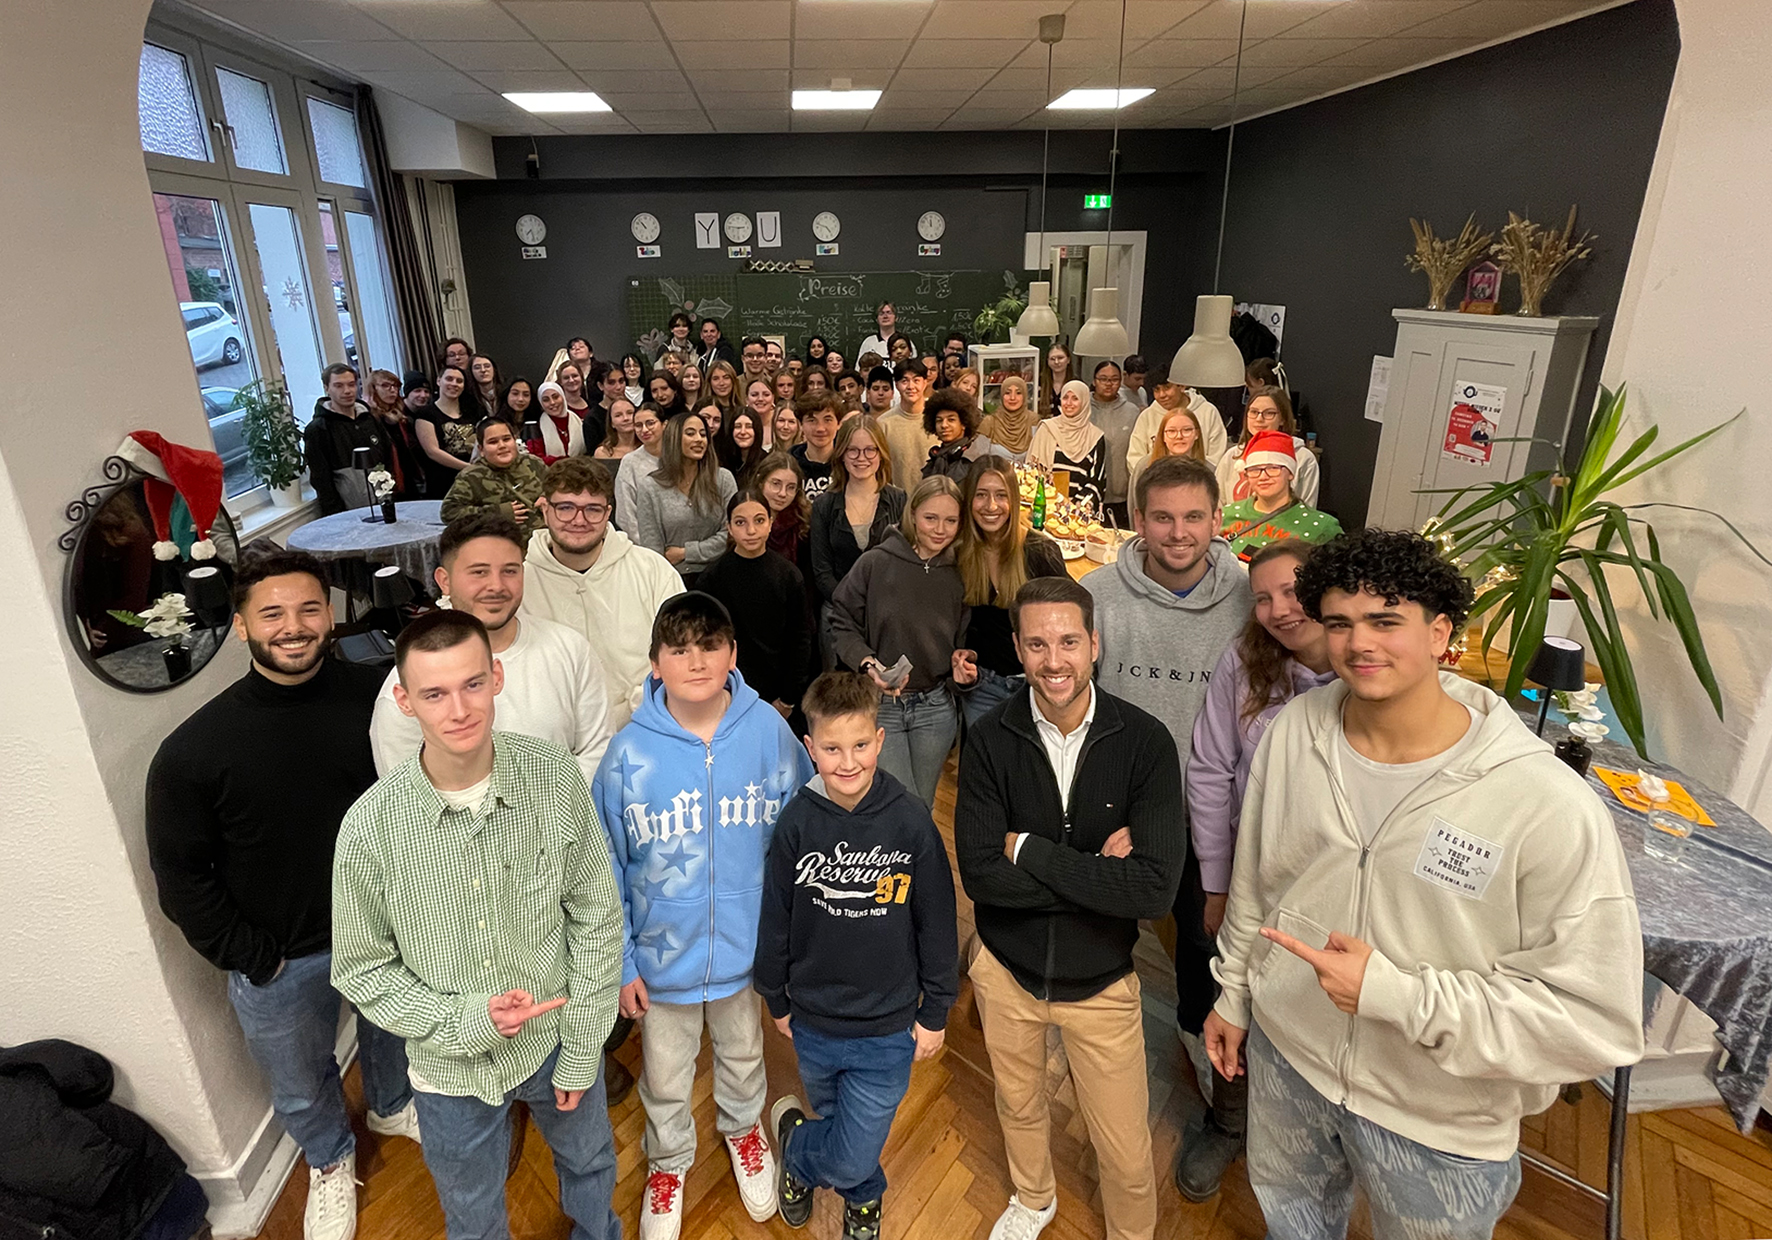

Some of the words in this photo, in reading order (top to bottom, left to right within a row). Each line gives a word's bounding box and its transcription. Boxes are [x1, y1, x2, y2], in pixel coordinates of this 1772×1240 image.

[697, 218, 715, 245] Y
[760, 215, 777, 243] U
[808, 278, 858, 297] Preise
[741, 307, 770, 315] Warme
[718, 779, 780, 828] nie
[1437, 829, 1491, 859] PEGADOR
[1438, 859, 1470, 877] PROCESS
[1450, 857, 1463, 868] THE
[794, 851, 891, 885] Reserve
[874, 872, 911, 904] 97
[844, 908, 868, 918] TIGERS
[870, 907, 888, 916] NOW
